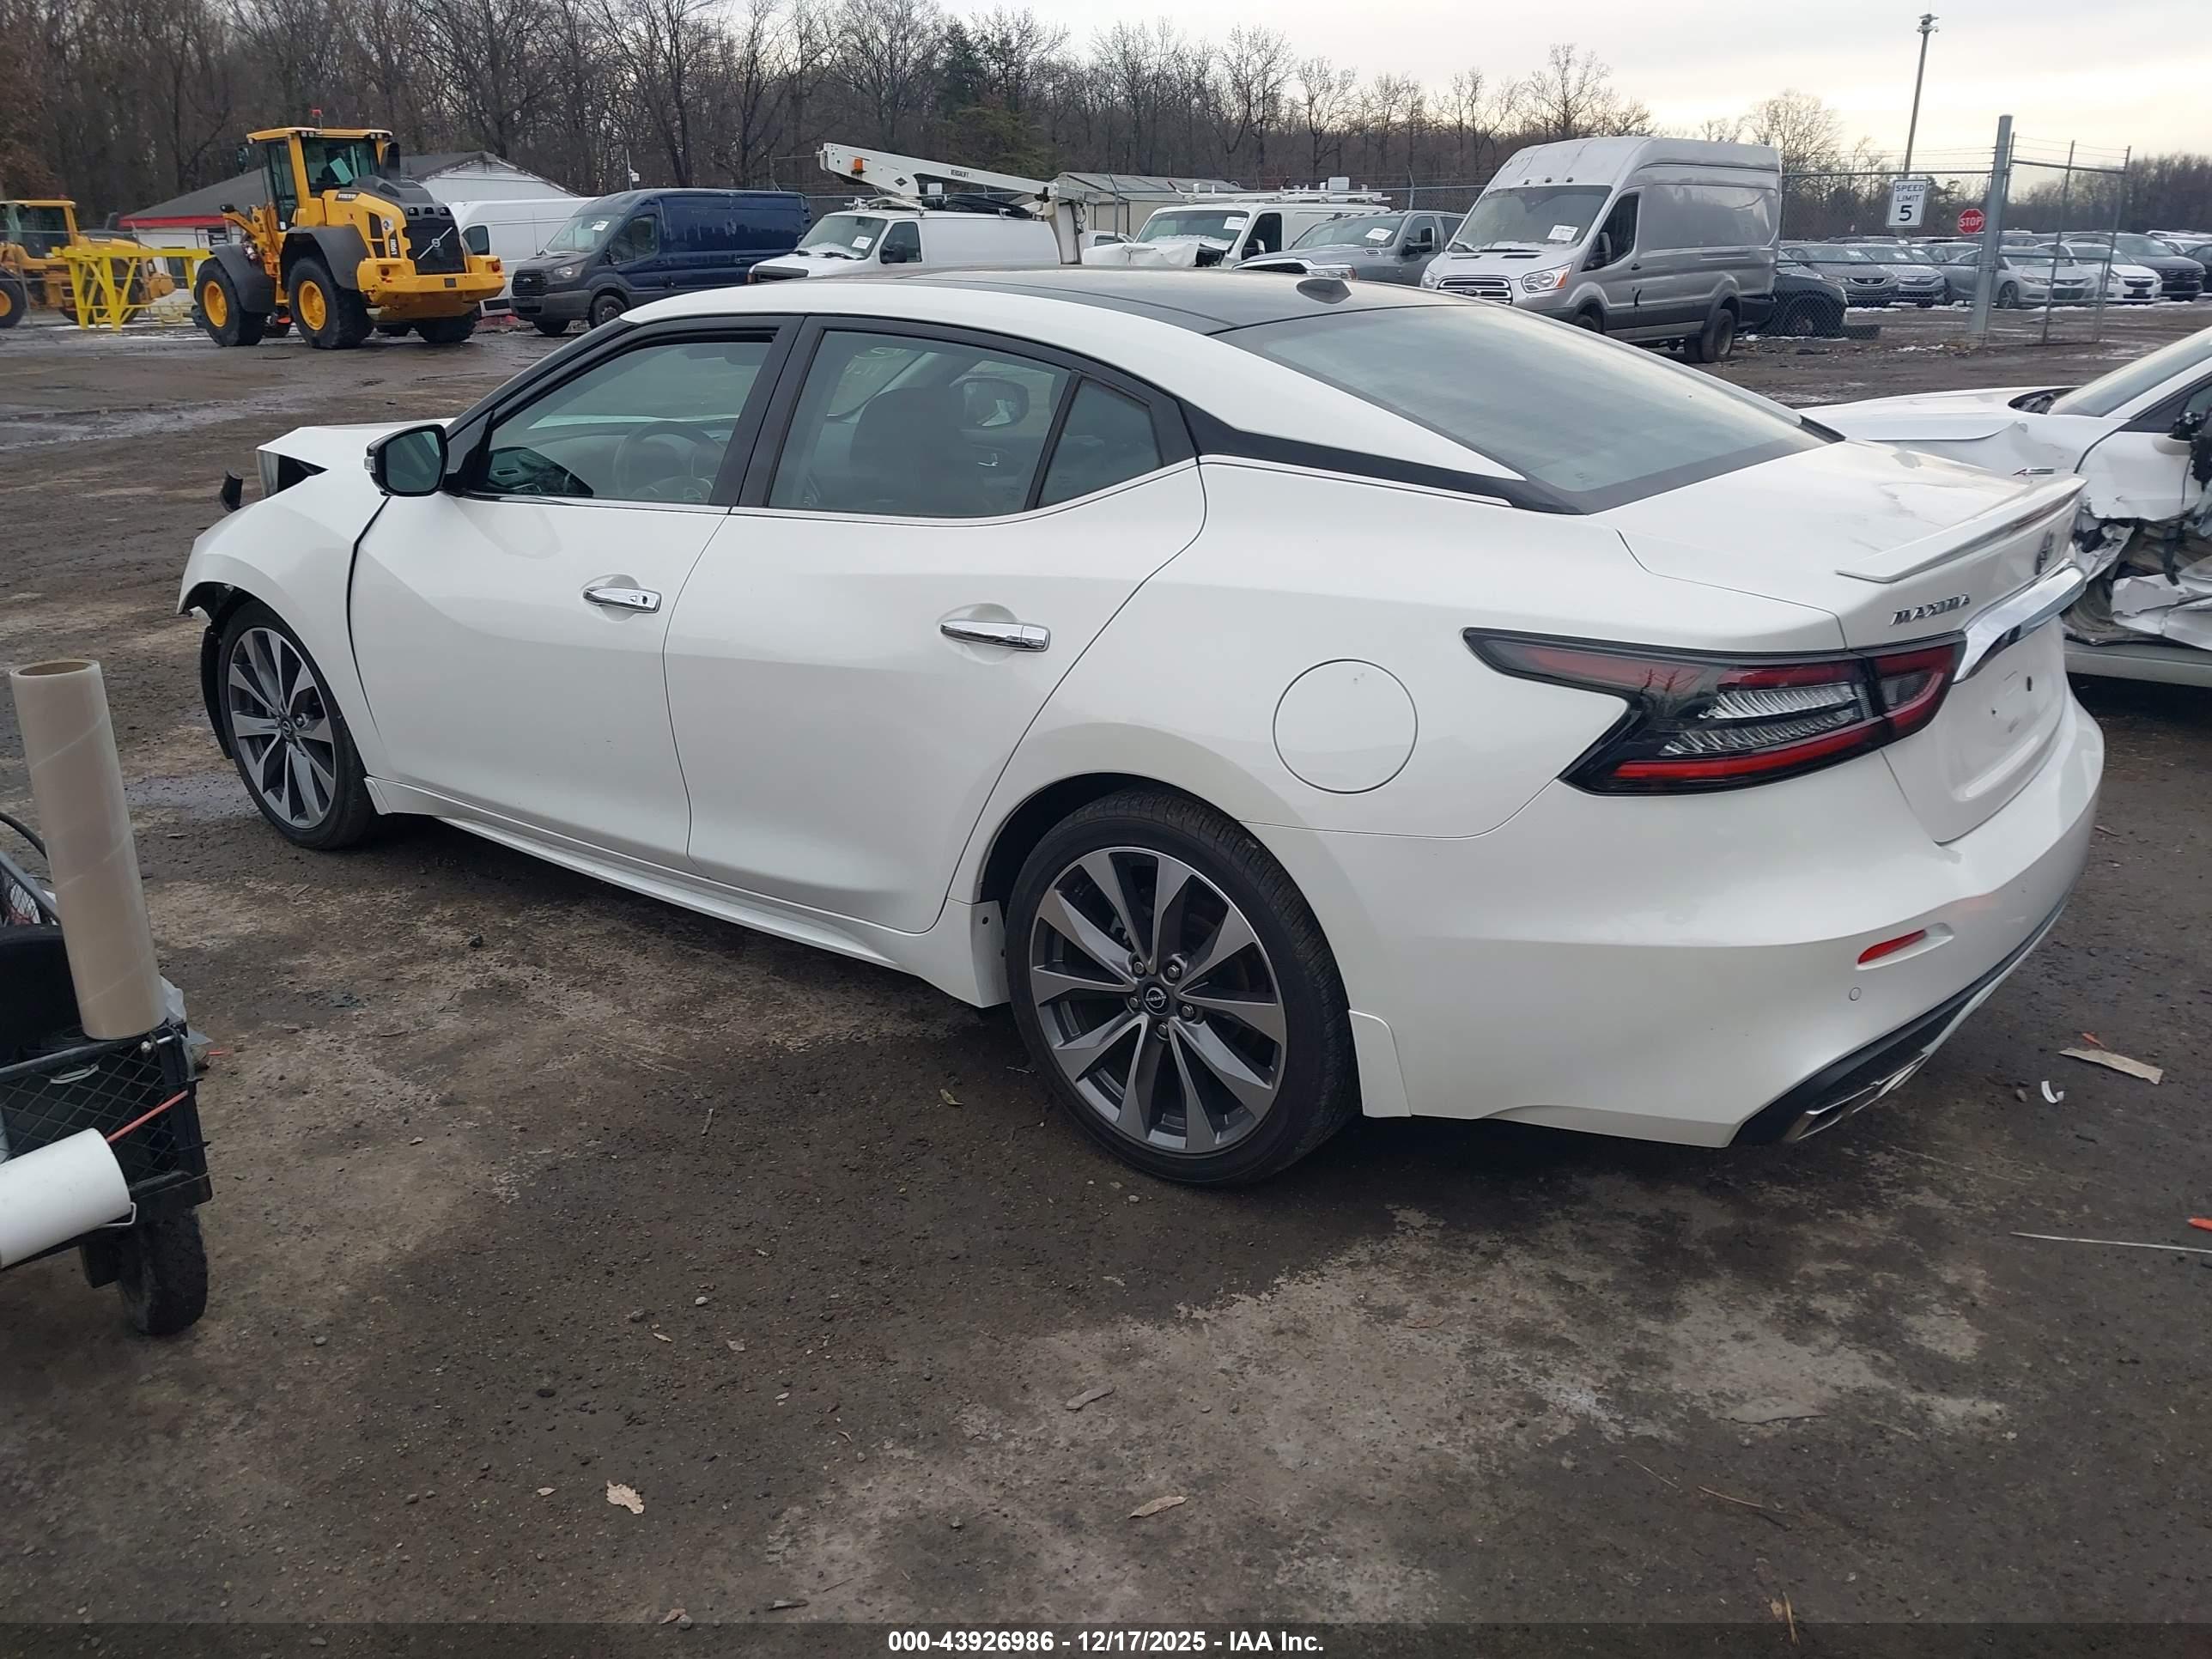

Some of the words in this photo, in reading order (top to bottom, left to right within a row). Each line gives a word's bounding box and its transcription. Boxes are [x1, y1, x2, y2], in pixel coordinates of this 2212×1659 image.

[1899, 205, 1913, 222] 5
[1959, 216, 1984, 228] STOP
[1889, 592, 1971, 626] MAXIMA
